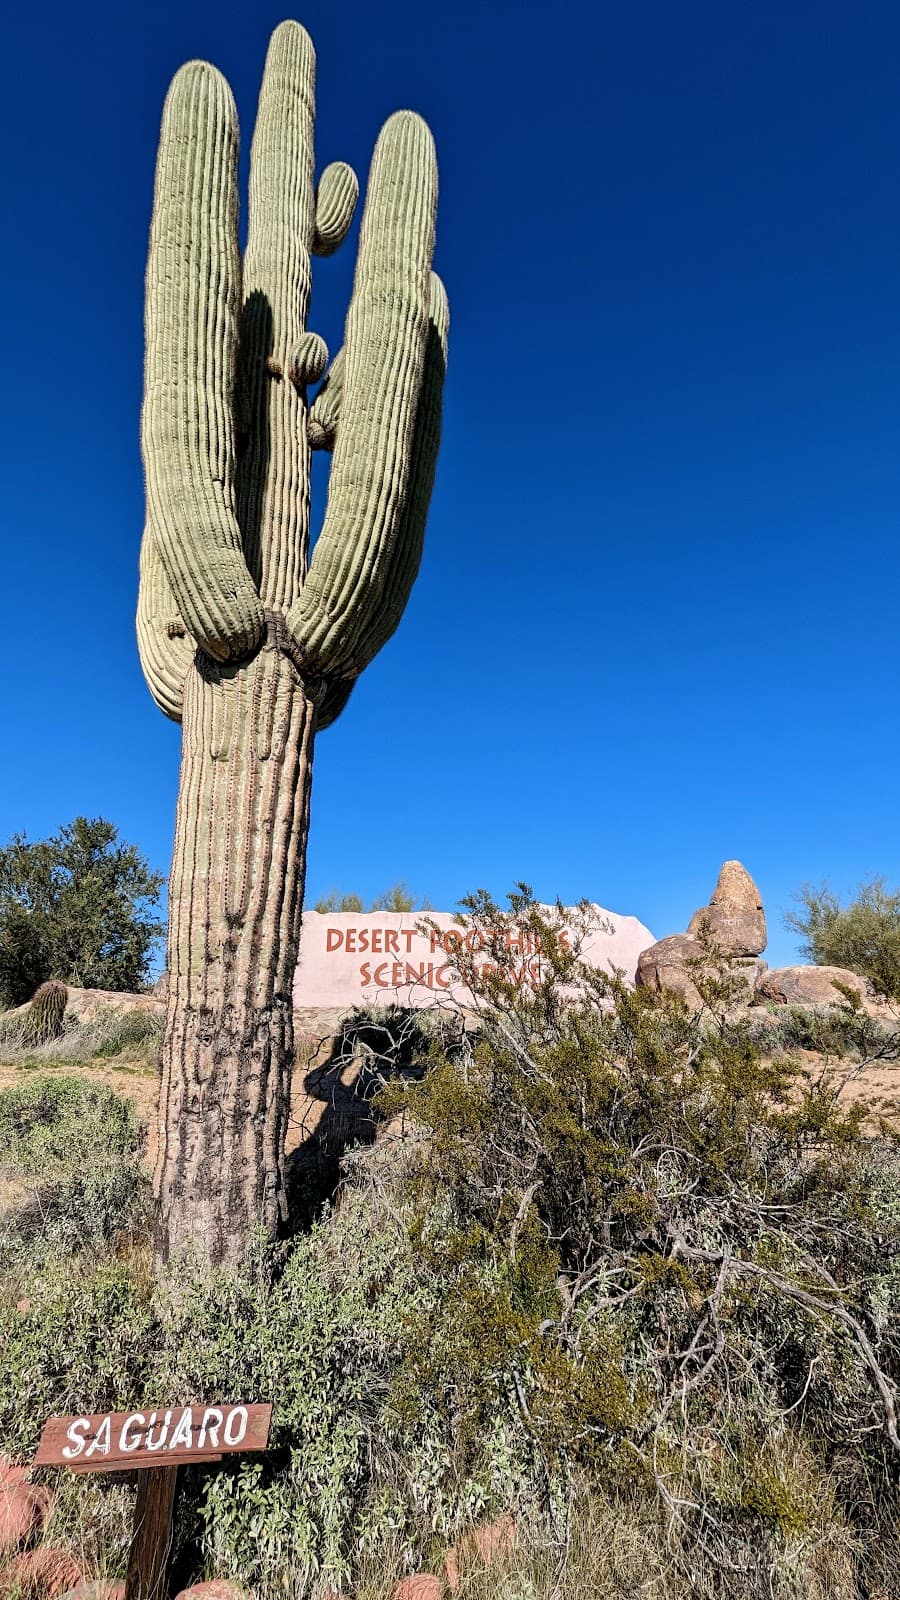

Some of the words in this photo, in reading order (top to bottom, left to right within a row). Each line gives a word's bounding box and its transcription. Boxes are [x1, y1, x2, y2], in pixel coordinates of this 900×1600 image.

[326, 928, 418, 953] DESERT
[359, 962, 450, 988] SCENIC
[61, 1405, 249, 1459] SAGUARO
